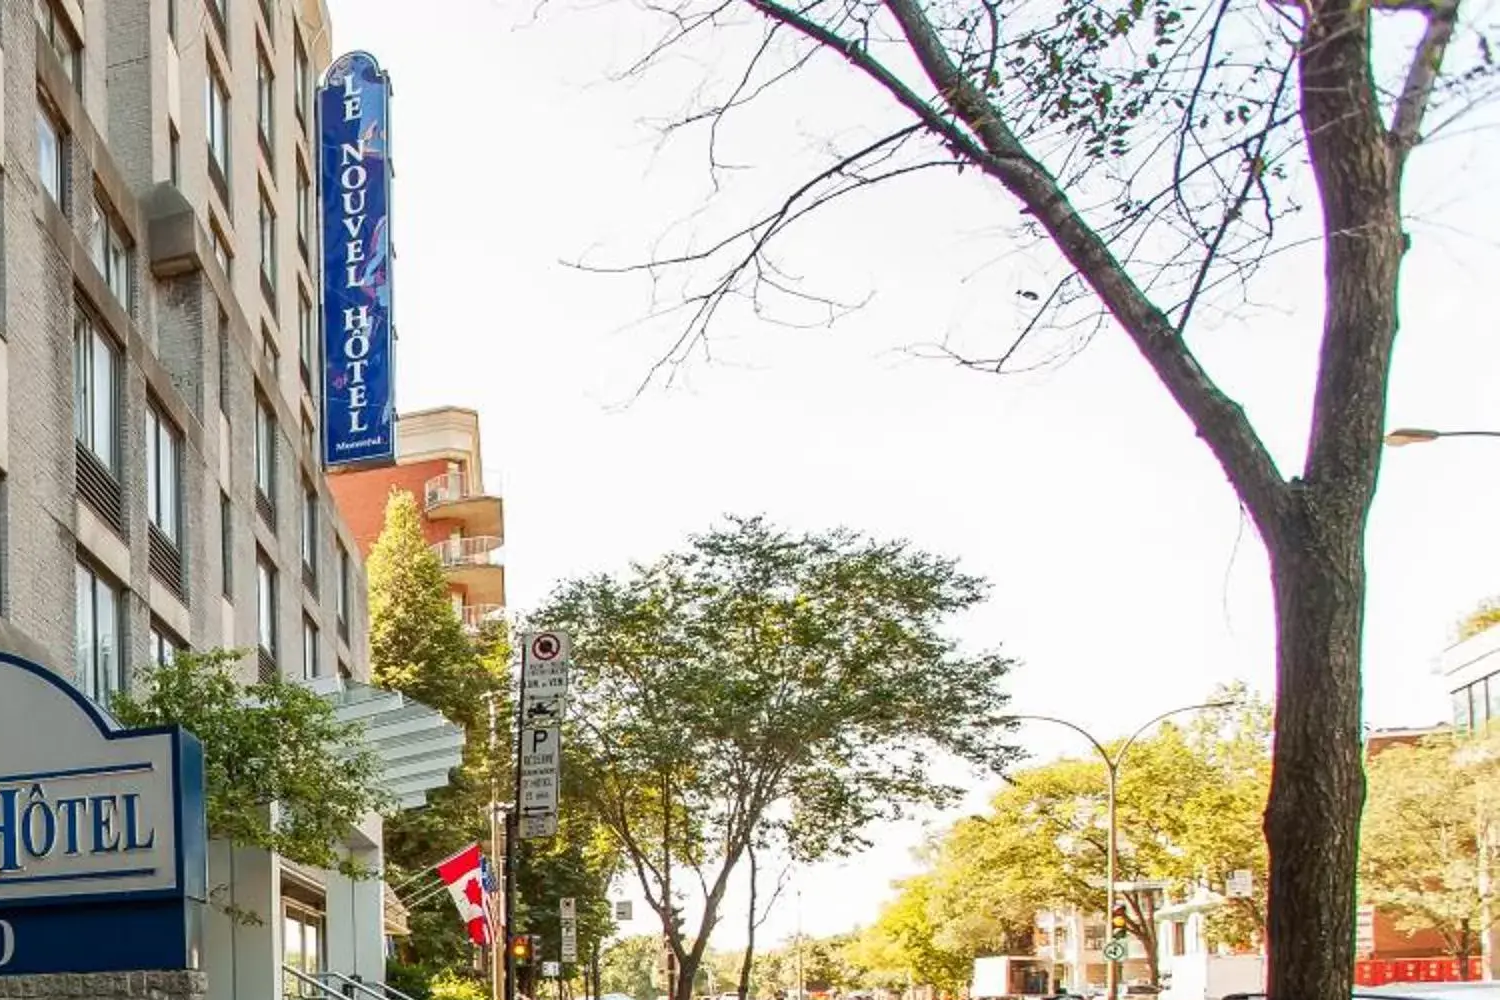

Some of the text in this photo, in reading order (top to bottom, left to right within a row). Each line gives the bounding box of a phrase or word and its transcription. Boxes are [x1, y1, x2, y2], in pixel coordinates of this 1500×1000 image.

[340, 75, 369, 433] LE NOUVEL HÔTEL
[533, 729, 548, 753] P
